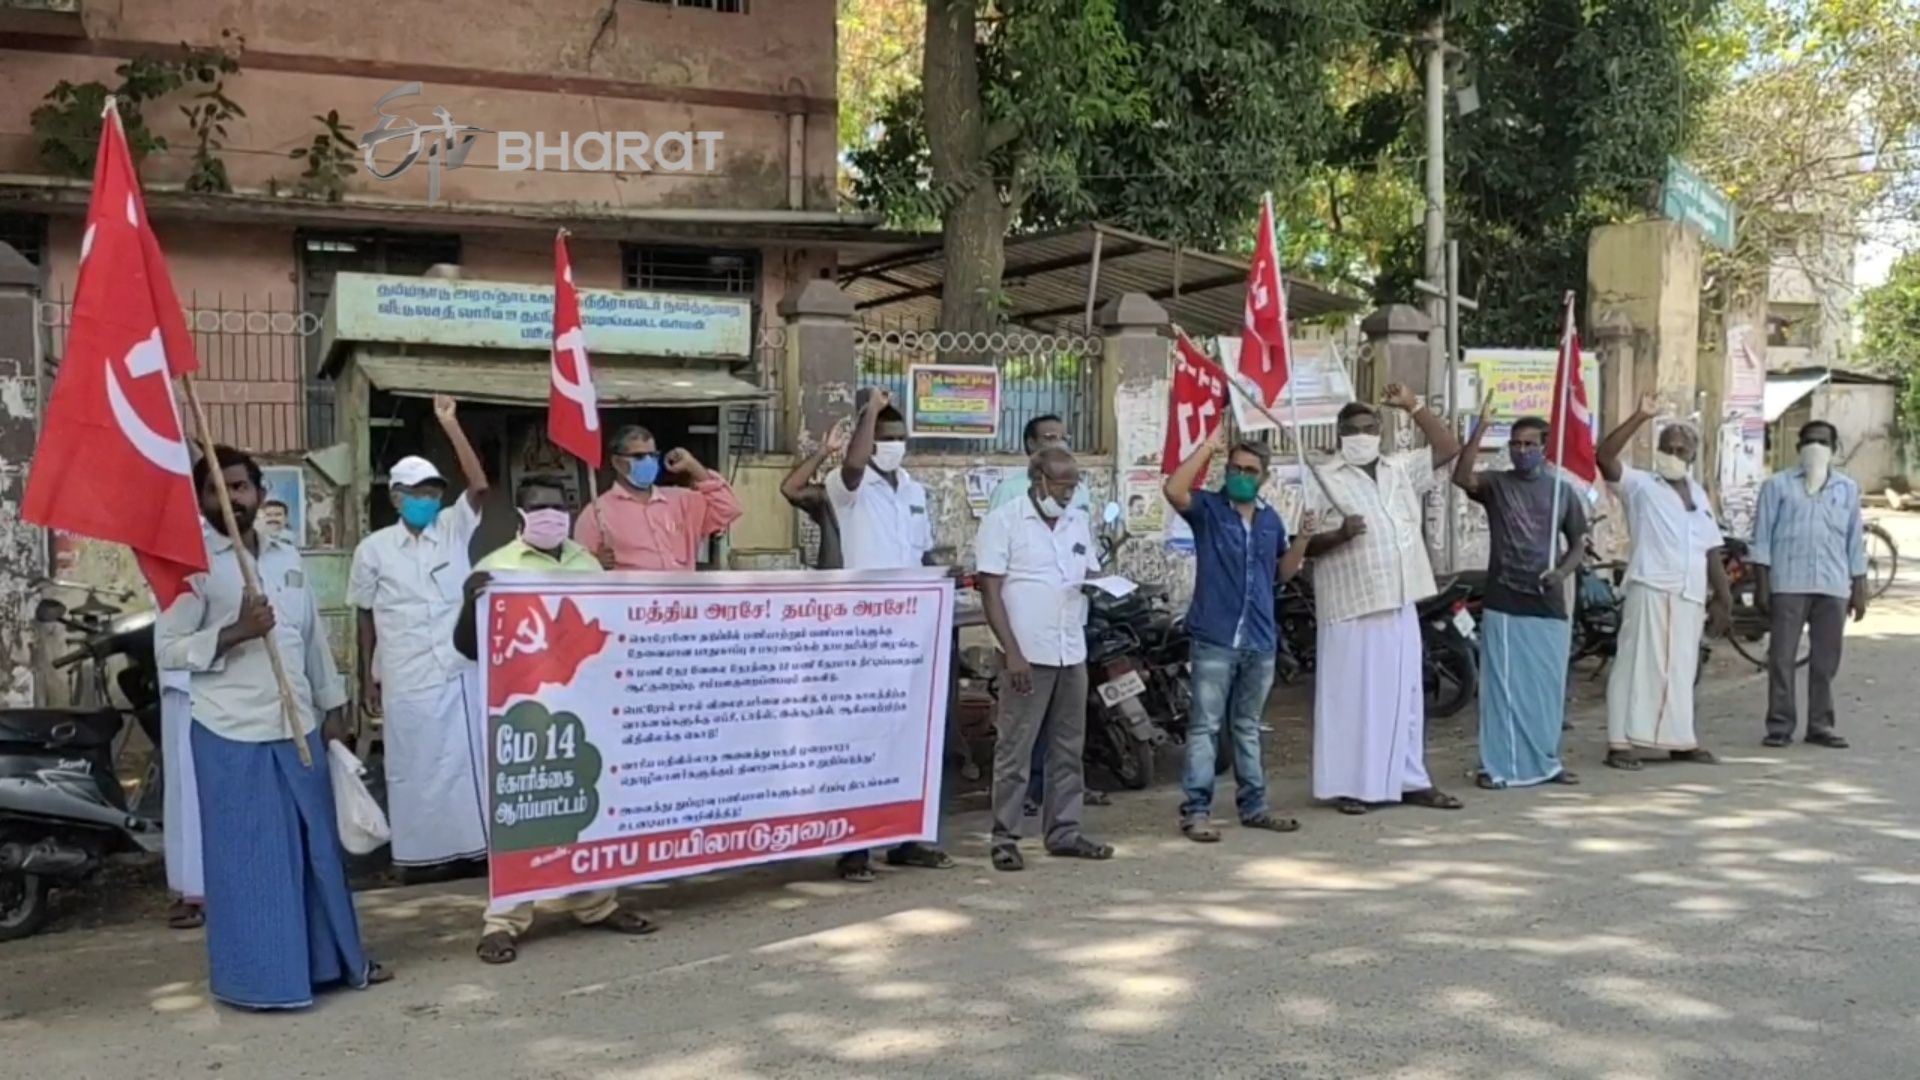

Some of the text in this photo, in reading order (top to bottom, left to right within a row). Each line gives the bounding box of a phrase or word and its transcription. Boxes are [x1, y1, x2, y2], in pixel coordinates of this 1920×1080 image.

[628, 595, 917, 625] மத்திய அரசே! தமிழக அரசே!!
[637, 666, 662, 678] மணி
[791, 660, 815, 671] மணி
[496, 723, 576, 765] மே 14
[496, 768, 574, 795] கோரிக்கை
[495, 788, 588, 826] ஆர்ப்பாட்டம்
[571, 815, 856, 874] CITU மயிலாடுதுறை.
